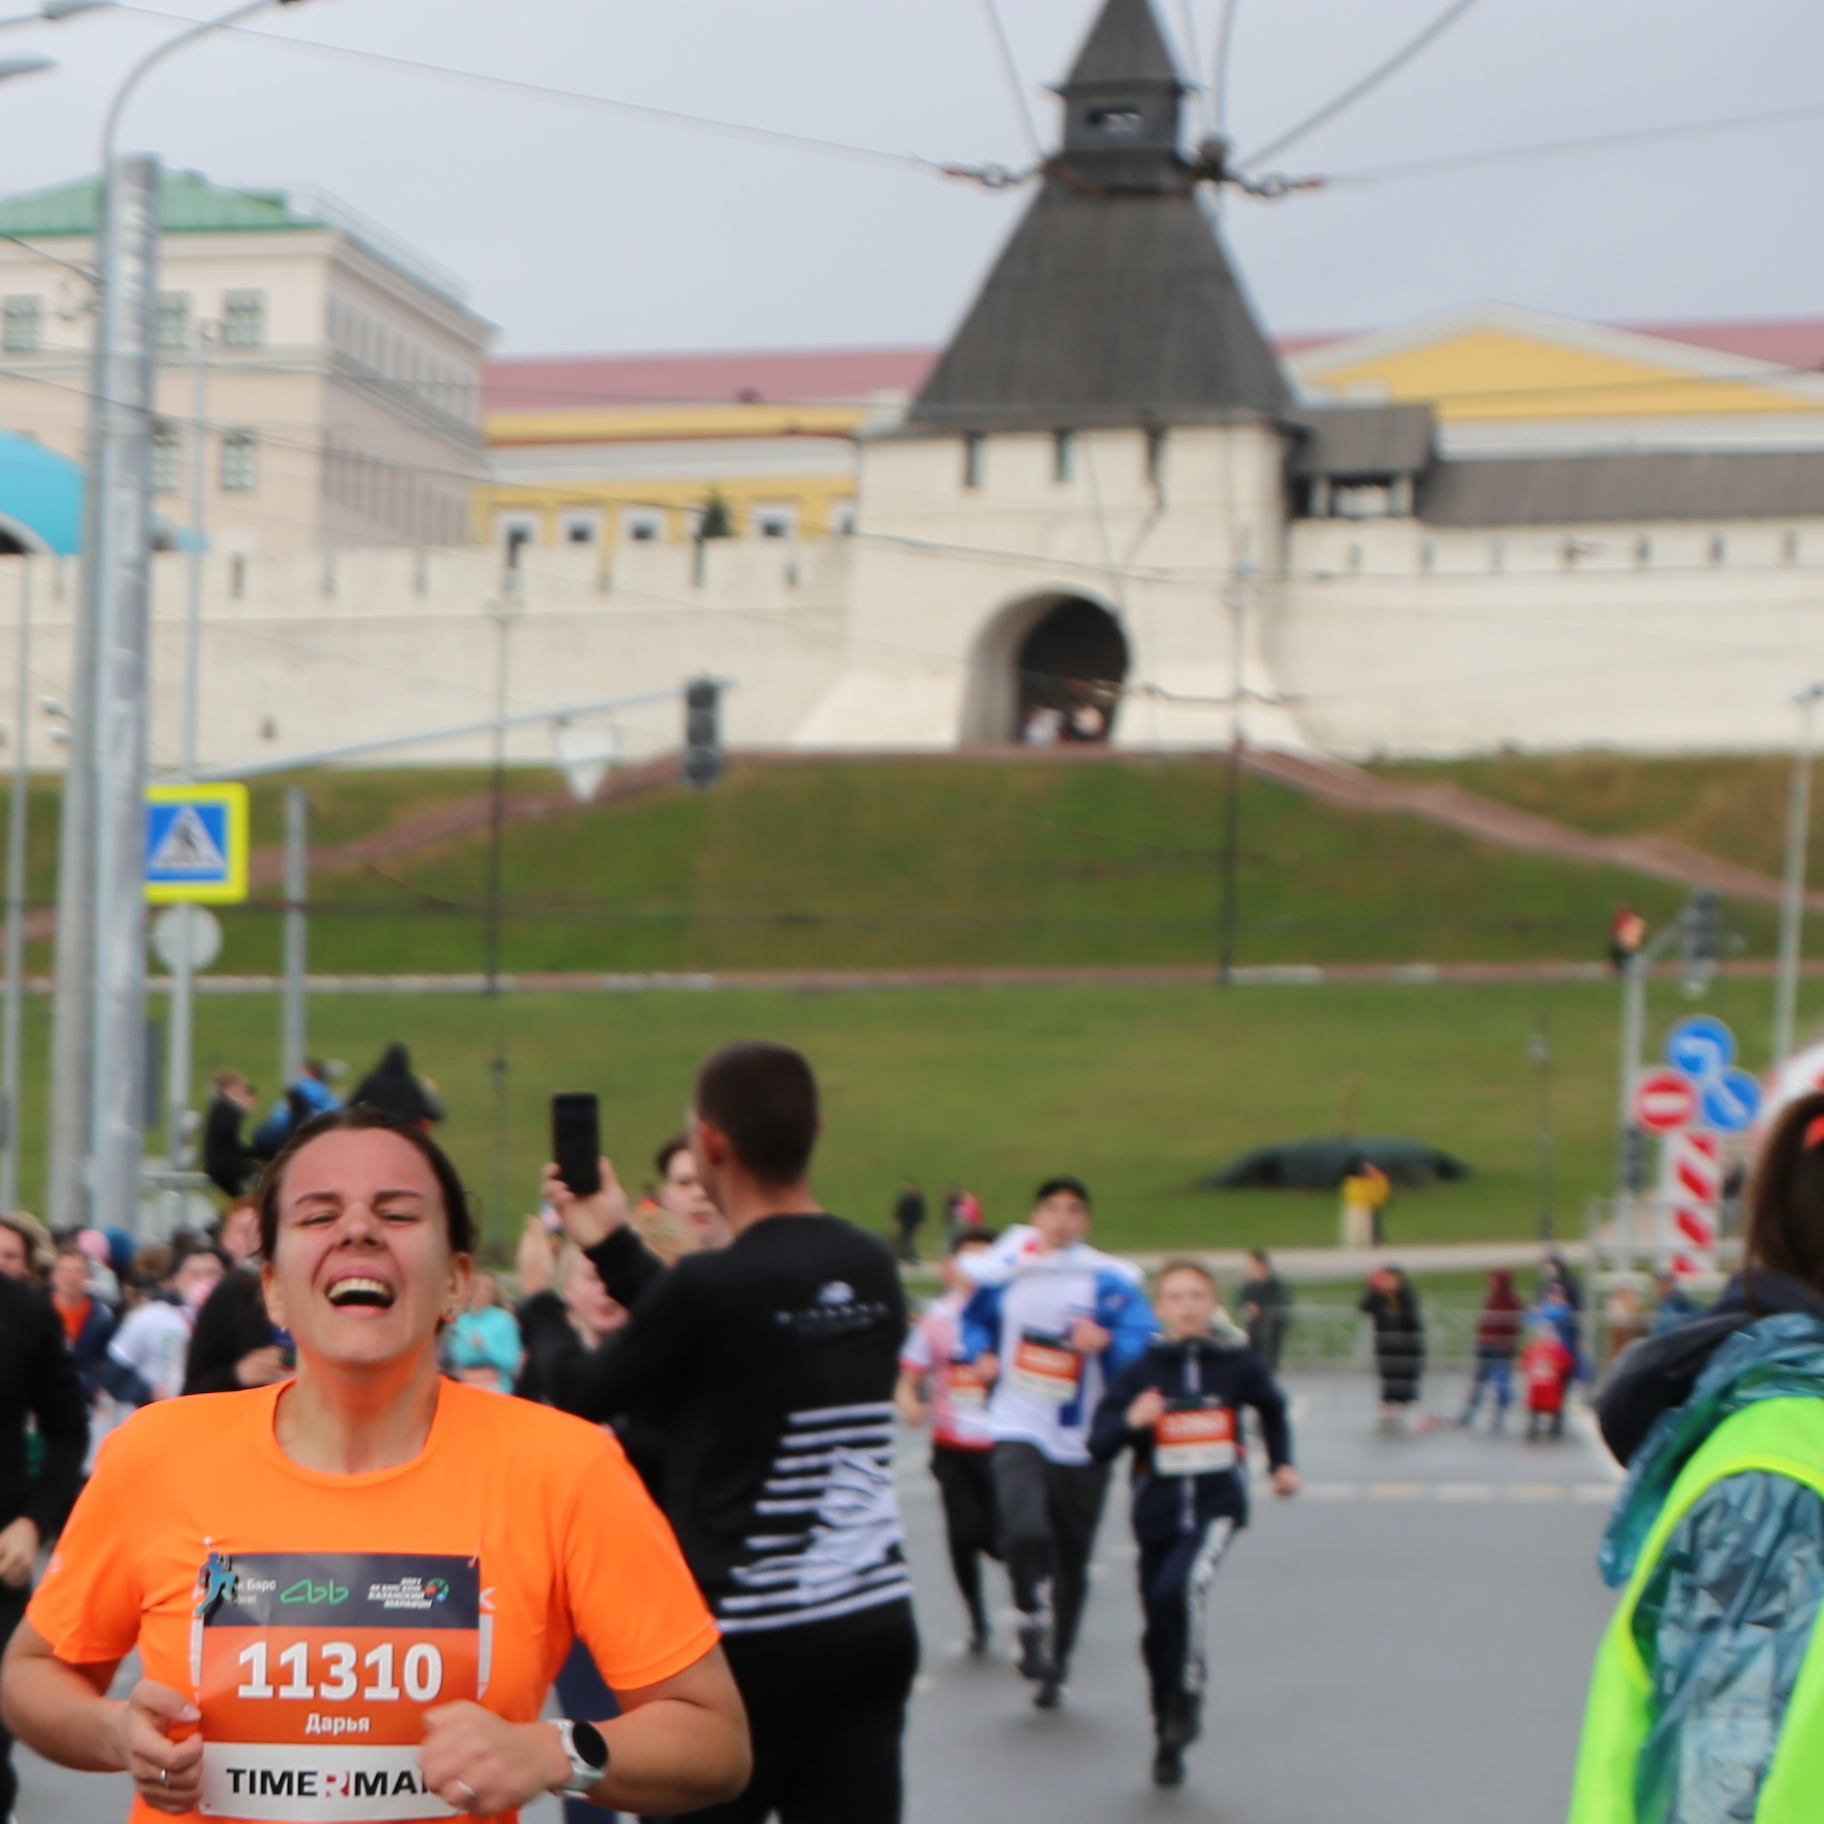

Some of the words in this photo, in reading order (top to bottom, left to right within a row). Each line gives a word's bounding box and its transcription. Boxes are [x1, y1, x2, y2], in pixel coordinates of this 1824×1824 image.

[237, 1640, 443, 1701] 11310
[305, 1712, 370, 1735] Дарья
[227, 1767, 429, 1797] TIMERMA
